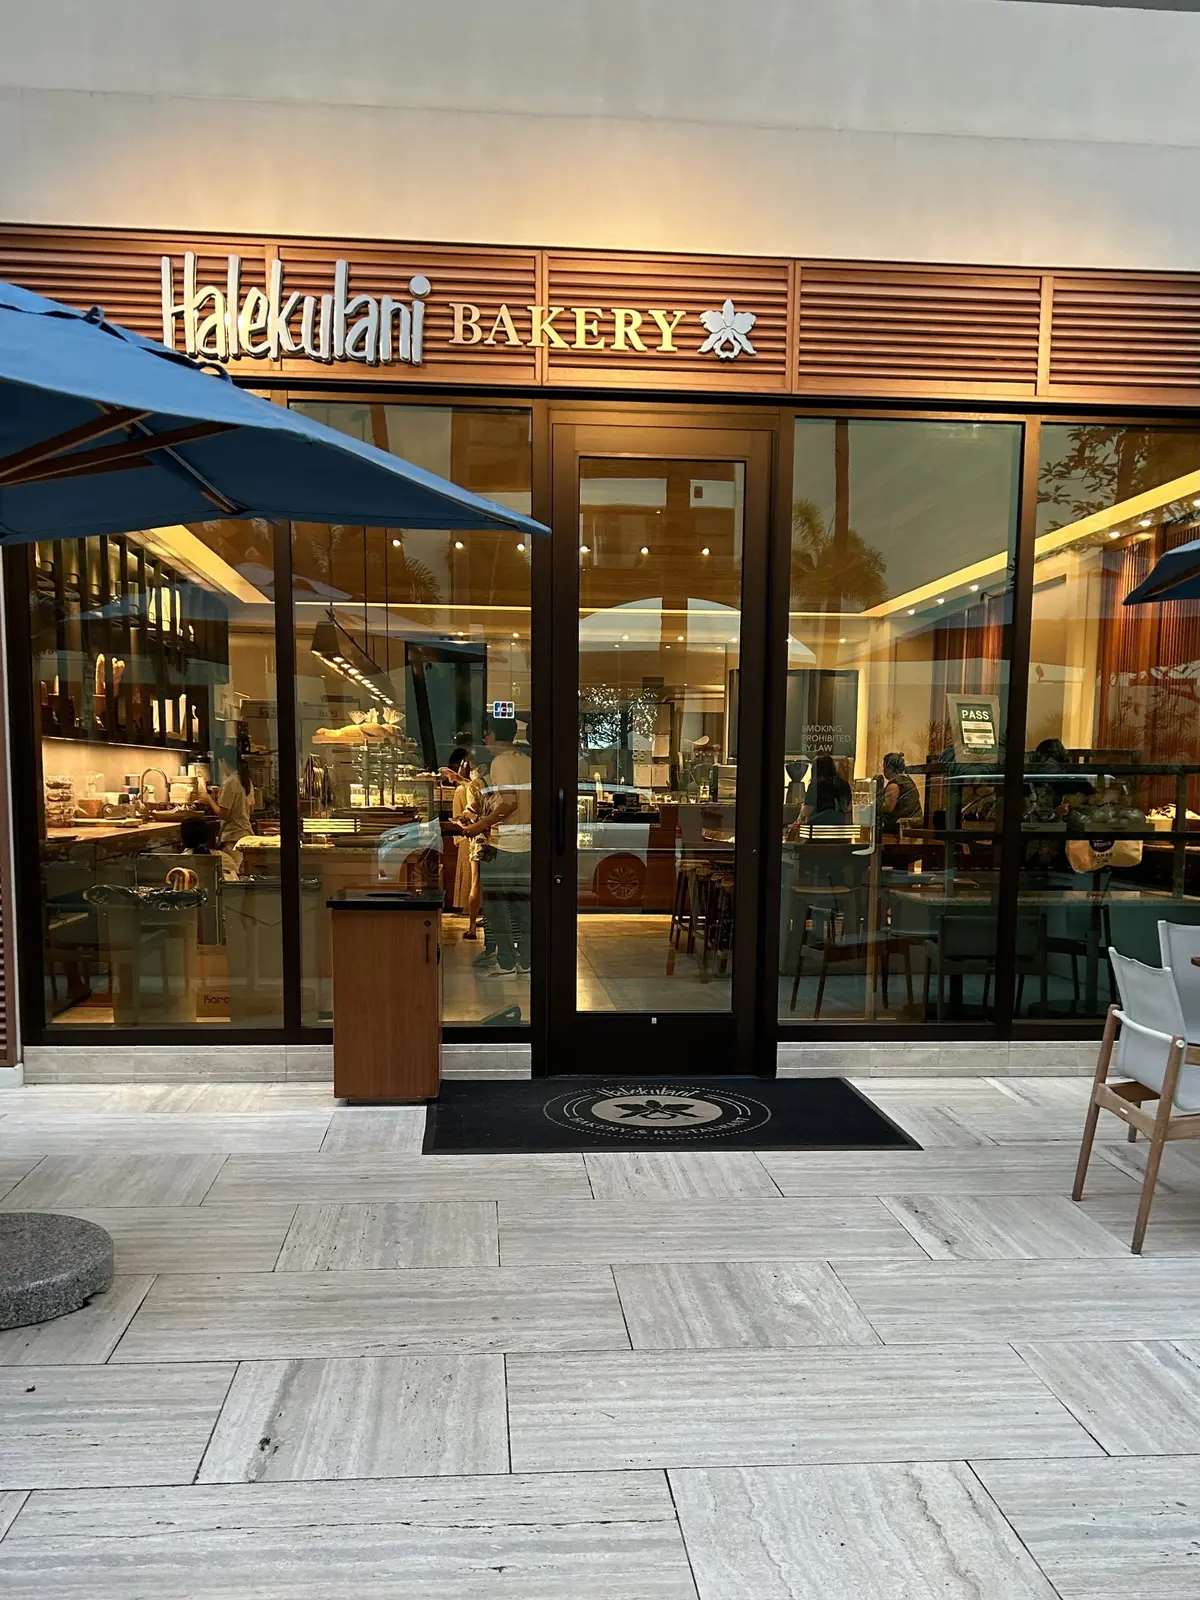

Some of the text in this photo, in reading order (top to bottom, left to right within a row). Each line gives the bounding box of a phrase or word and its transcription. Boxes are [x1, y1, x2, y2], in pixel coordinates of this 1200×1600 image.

[161, 251, 686, 366] Halekulani BAKERY
[961, 709, 990, 720] PASS
[802, 725, 842, 733] SMOKING
[802, 734, 852, 743] PROHIBITED
[801, 744, 833, 752] BY LAW
